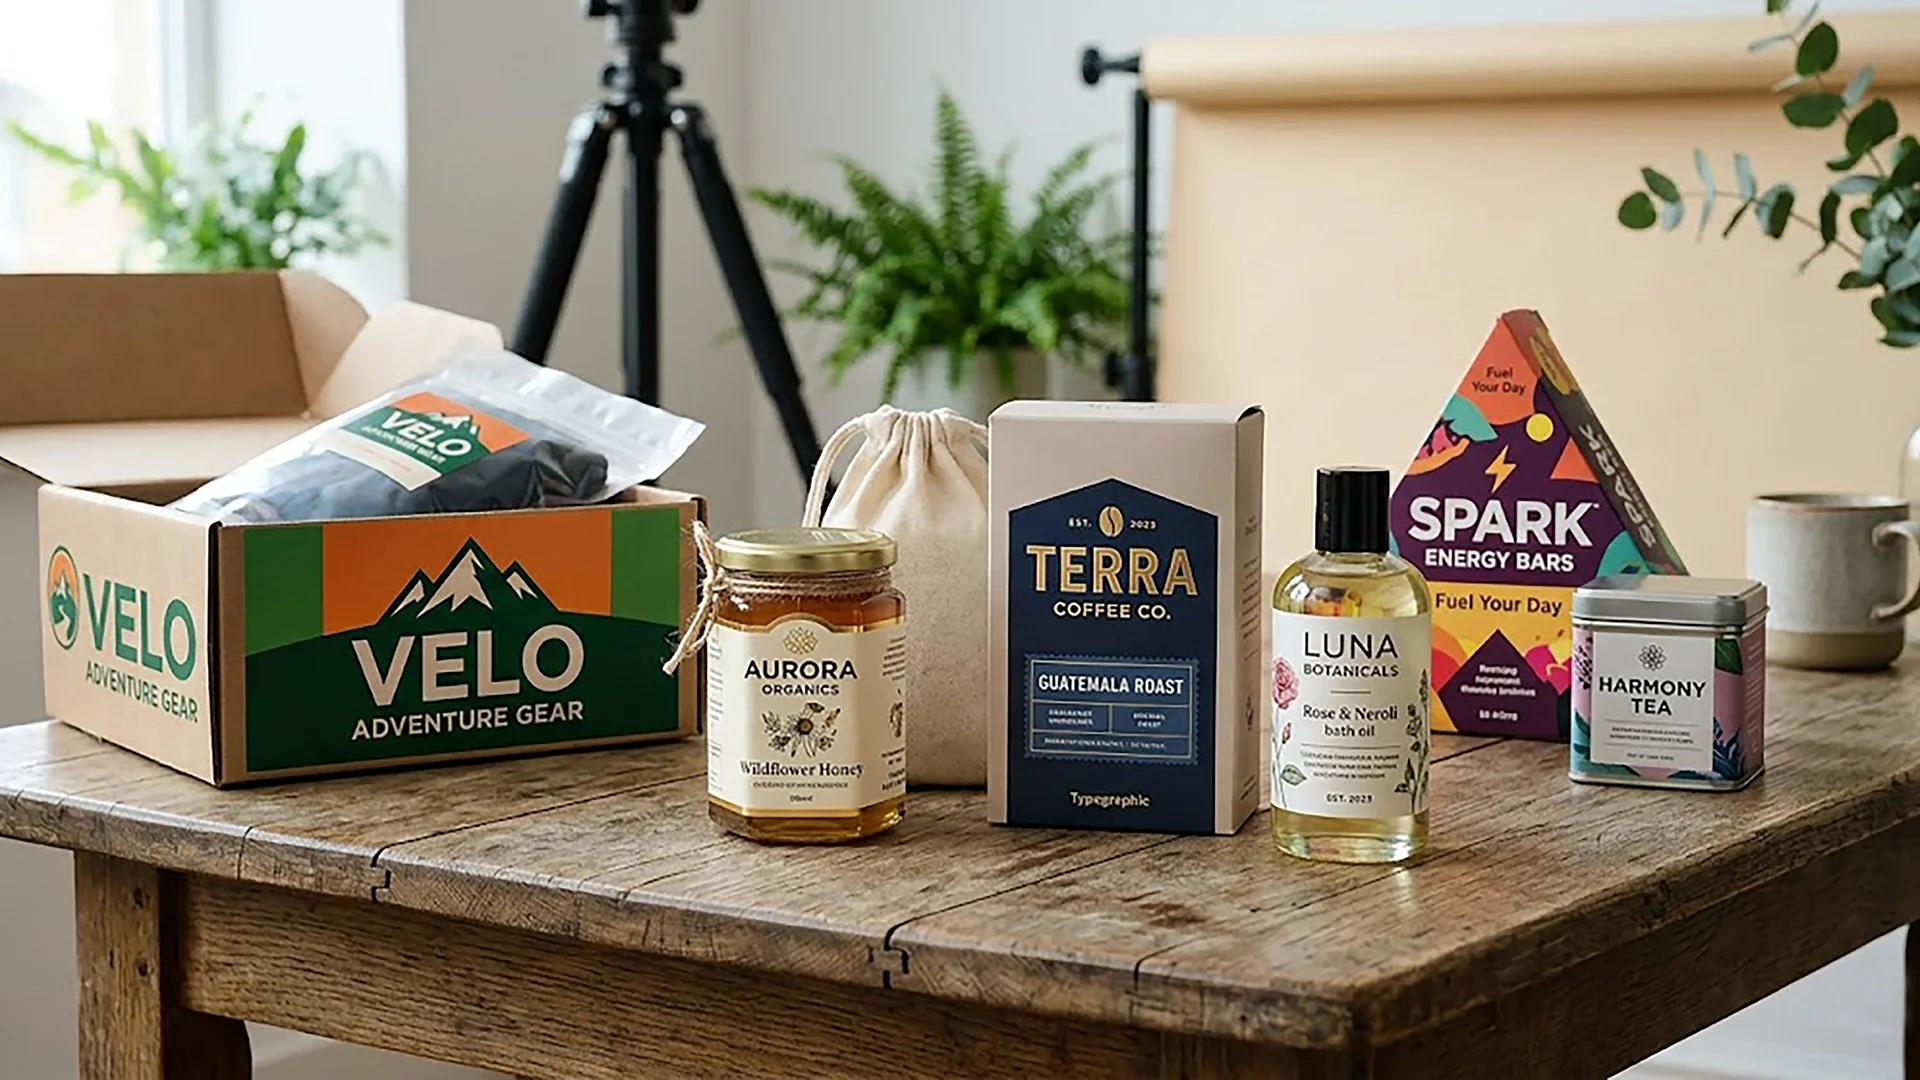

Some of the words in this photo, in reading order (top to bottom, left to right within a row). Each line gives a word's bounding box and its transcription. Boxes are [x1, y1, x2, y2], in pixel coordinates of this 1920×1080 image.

[1486, 366, 1513, 379] Fuel
[1472, 381, 1500, 394] Your
[1502, 382, 1526, 397] Day
[381, 411, 472, 456] VELO
[1407, 496, 1594, 547] SPARK
[1026, 544, 1198, 595] TERRA
[1425, 548, 1511, 570] ENERGY
[1516, 552, 1575, 572] BARS
[1053, 601, 1131, 619] COFFEE
[1138, 604, 1172, 620] CO.
[1435, 592, 1474, 610] Fuel
[1480, 595, 1521, 612] Your
[1527, 597, 1563, 617] Day
[82, 573, 196, 681] VELO
[1304, 631, 1399, 659] LUNA
[351, 624, 585, 707] VELO
[744, 660, 858, 680] AURORA
[1303, 663, 1400, 678] BOTANICALS
[85, 660, 158, 708] ADVENTURE
[161, 685, 199, 723] GEAR
[761, 684, 840, 696] ORGANICS
[1038, 674, 1130, 693] GUATEMALA
[1135, 677, 1184, 694] ROAST
[1599, 676, 1706, 698] HARMONY
[1303, 704, 1336, 720] Rose
[1339, 706, 1351, 720] &
[1354, 705, 1398, 721] Neroli
[1631, 698, 1672, 715] TEA
[351, 707, 508, 740] ADVENTURE
[516, 700, 584, 723] GEAR
[1324, 724, 1355, 737] bath
[1358, 724, 1375, 737] oil
[740, 761, 816, 776] Wildflower
[819, 762, 864, 779] Honey
